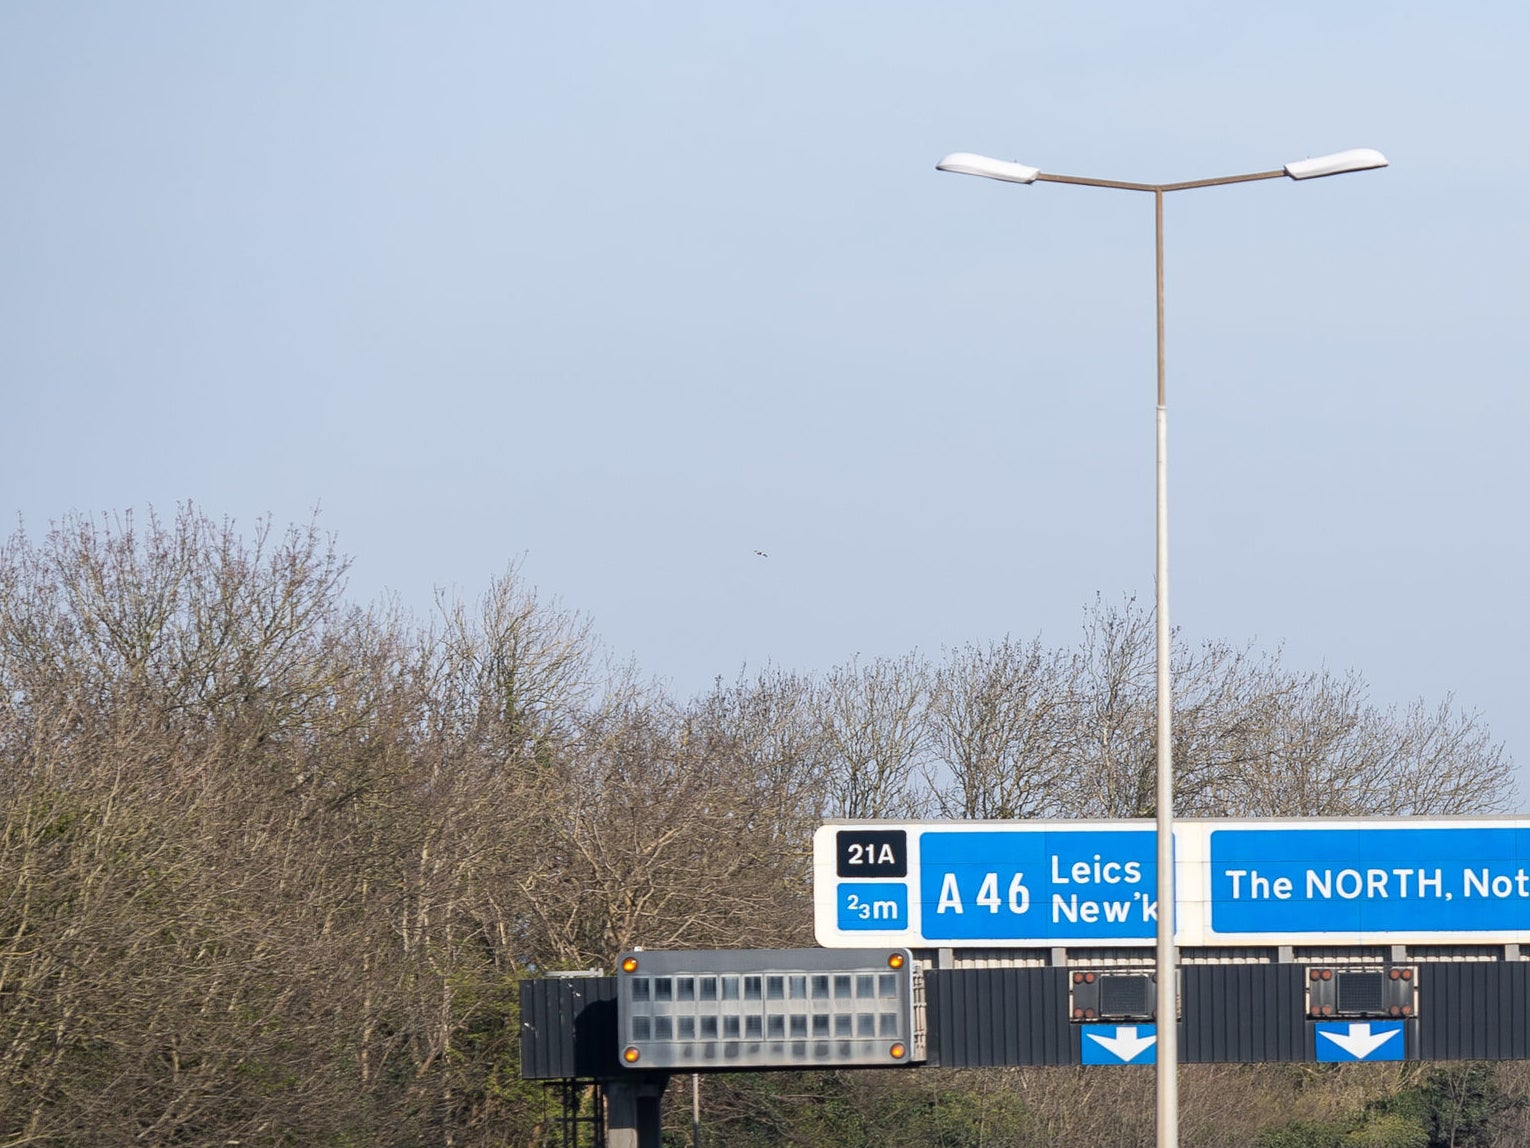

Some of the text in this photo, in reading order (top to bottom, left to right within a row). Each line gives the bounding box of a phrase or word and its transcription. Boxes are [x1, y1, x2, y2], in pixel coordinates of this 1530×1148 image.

[848, 844, 894, 864] 21A
[1052, 855, 1141, 884] Leics
[1226, 870, 1292, 900] The
[1306, 868, 1453, 901] NORTH,
